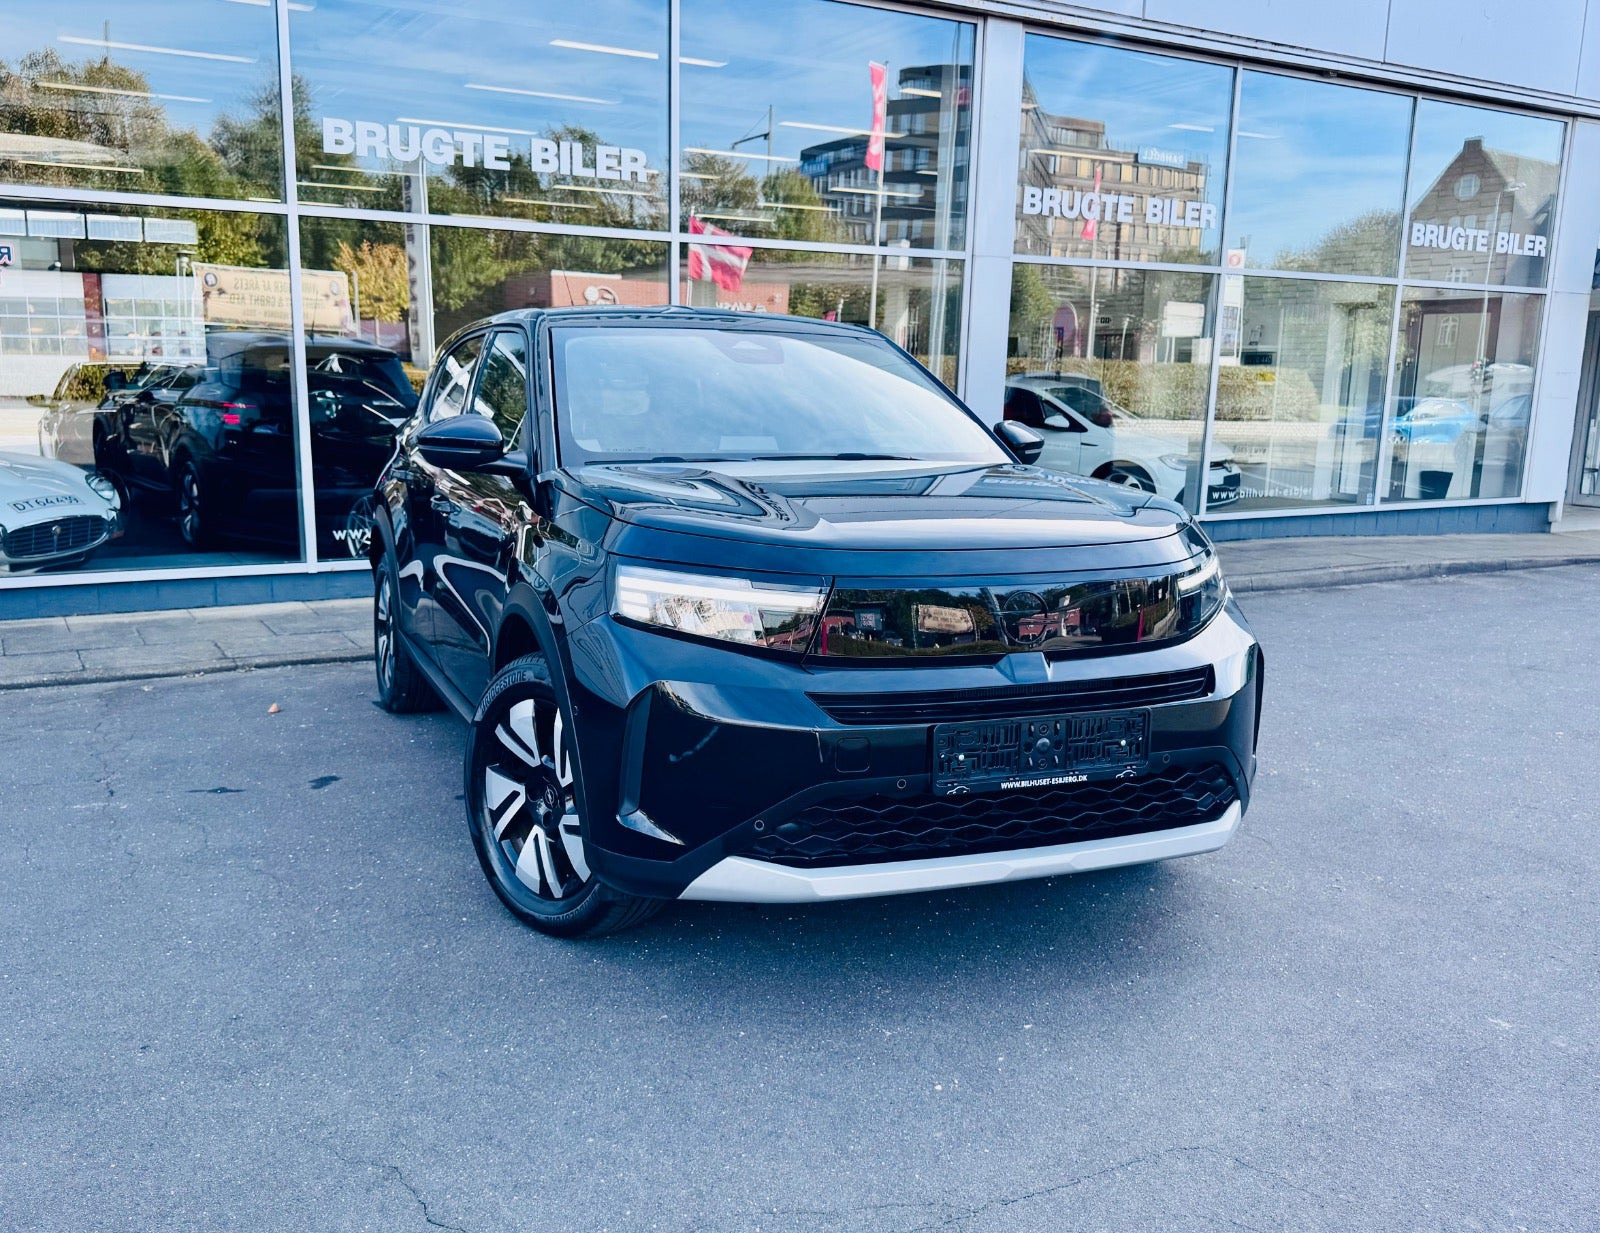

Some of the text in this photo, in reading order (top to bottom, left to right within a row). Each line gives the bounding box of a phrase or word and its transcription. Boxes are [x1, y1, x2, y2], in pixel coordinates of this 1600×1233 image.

[323, 118, 649, 183] BRUGTE BILER
[1023, 185, 1217, 229] BRUGTE BILER
[1411, 222, 1547, 258] BRUGTE BILER
[1212, 486, 1332, 499] www.bilhuset-esbjer.k
[1001, 774, 1087, 789] WWW.BILHUSET-ESBJERG.DK
